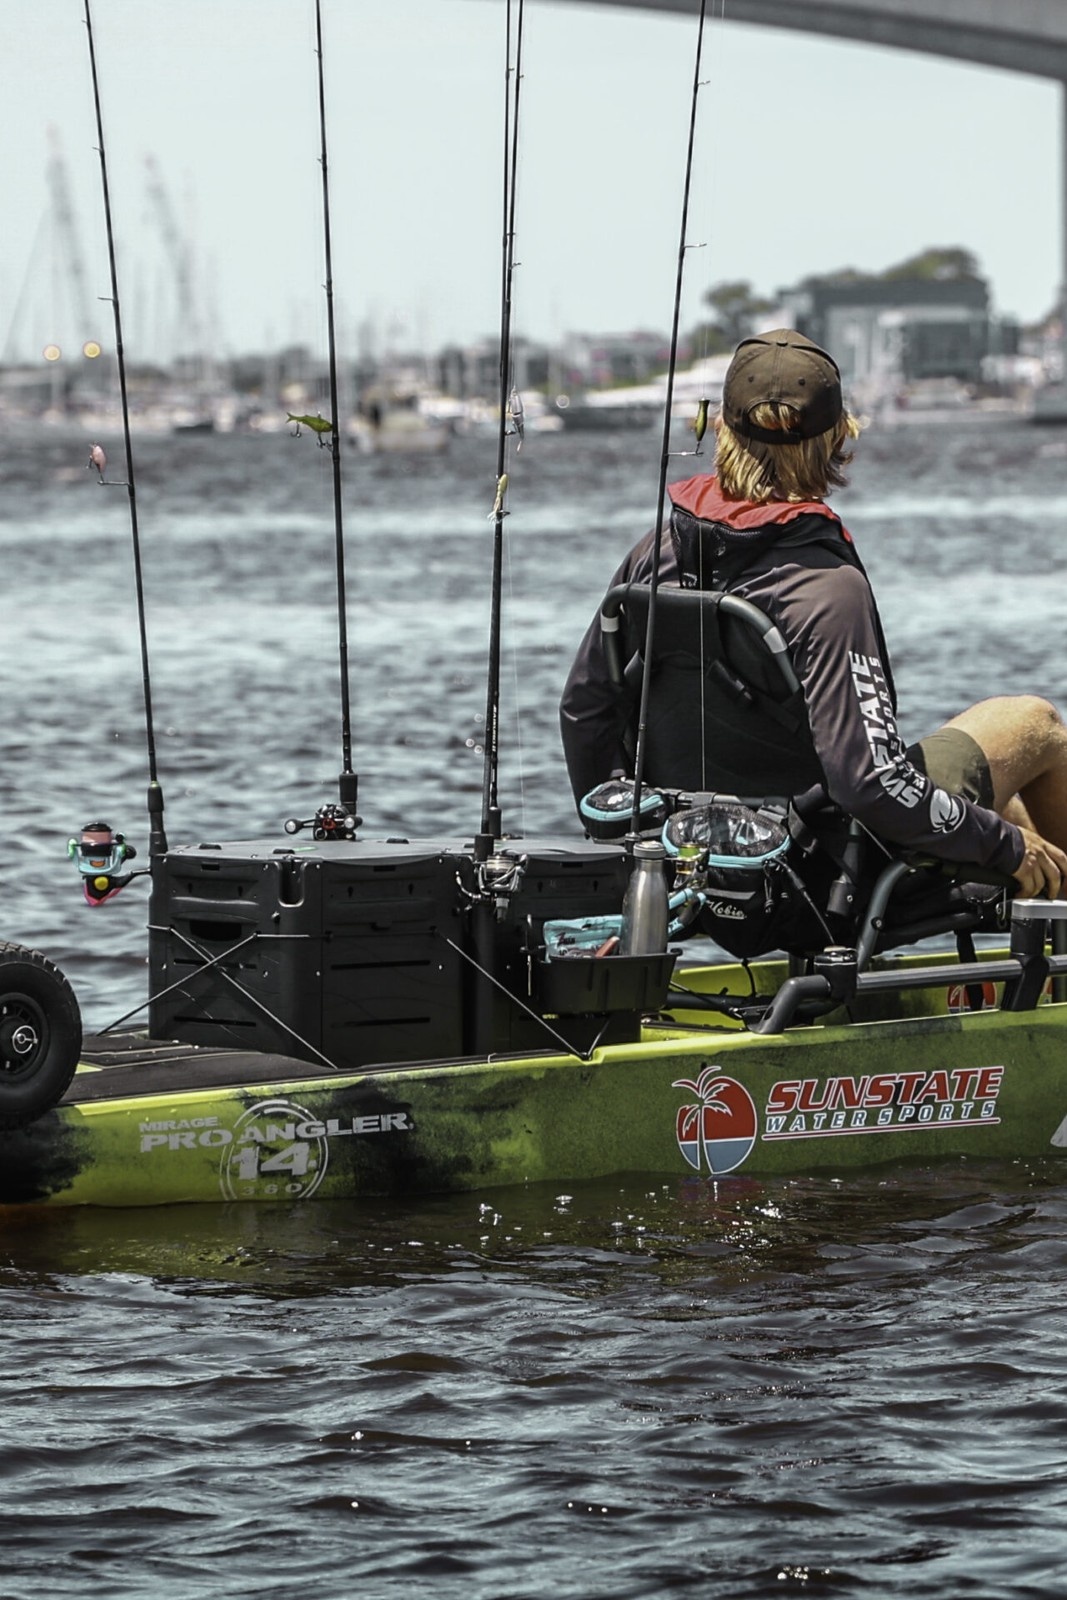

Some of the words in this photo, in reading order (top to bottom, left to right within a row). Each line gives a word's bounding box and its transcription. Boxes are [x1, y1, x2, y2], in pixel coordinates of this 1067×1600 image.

[765, 1066, 1004, 1114] SUNSTATE
[139, 1117, 218, 1133] MIRAGE
[140, 1129, 233, 1153] PRO
[237, 1112, 413, 1144] ANGLER
[231, 1142, 310, 1180] 14
[240, 1183, 302, 1196] 360
